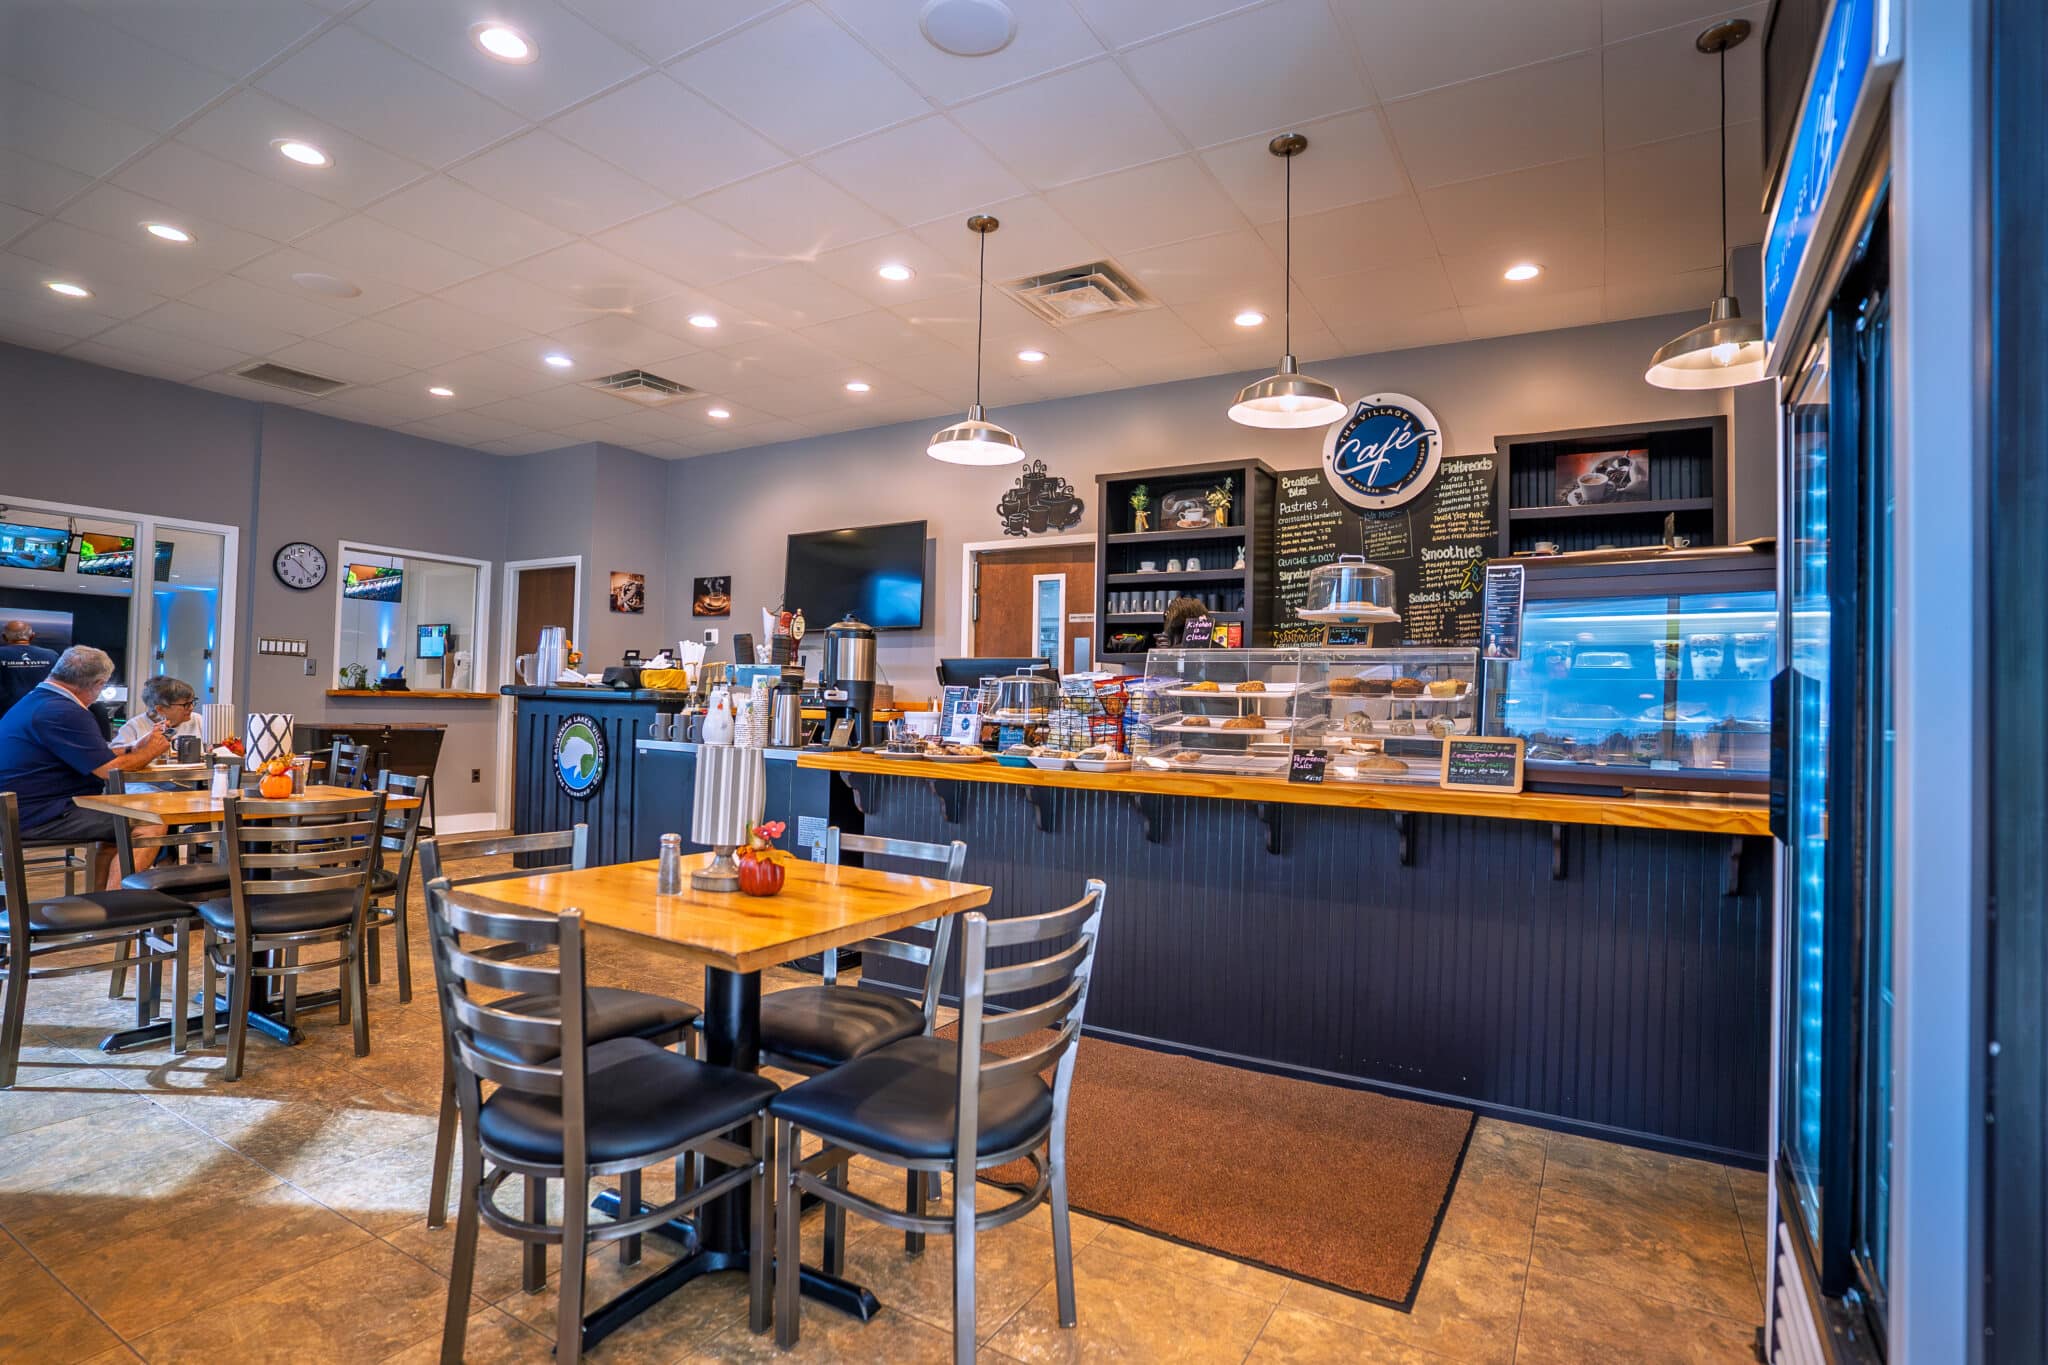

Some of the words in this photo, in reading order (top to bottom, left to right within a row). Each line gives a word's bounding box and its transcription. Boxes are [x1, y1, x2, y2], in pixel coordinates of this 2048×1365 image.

[1340, 423, 1357, 443] THE
[1360, 408, 1409, 421] VILLAGE
[1334, 421, 1436, 487] Café
[1441, 457, 1493, 475] Flatbreads
[1282, 473, 1320, 489] Breakfast
[1288, 486, 1308, 498] Bites
[1280, 500, 1318, 516] Pastries
[1321, 498, 1328, 509] 4
[1278, 556, 1308, 567] QUICHE
[1318, 552, 1335, 563] DAY
[1421, 545, 1483, 561] Smoothies
[1472, 566, 1478, 581] 8
[1409, 592, 1440, 604] Salads
[1448, 589, 1473, 601] Such
[1186, 621, 1212, 629] Kitchen
[1185, 632, 1210, 641] Closed
[1279, 632, 1321, 644] SANDWICH
[553, 718, 573, 760] SAVANNAH
[573, 715, 593, 728] LAKES
[592, 726, 604, 764] VILLAGE
